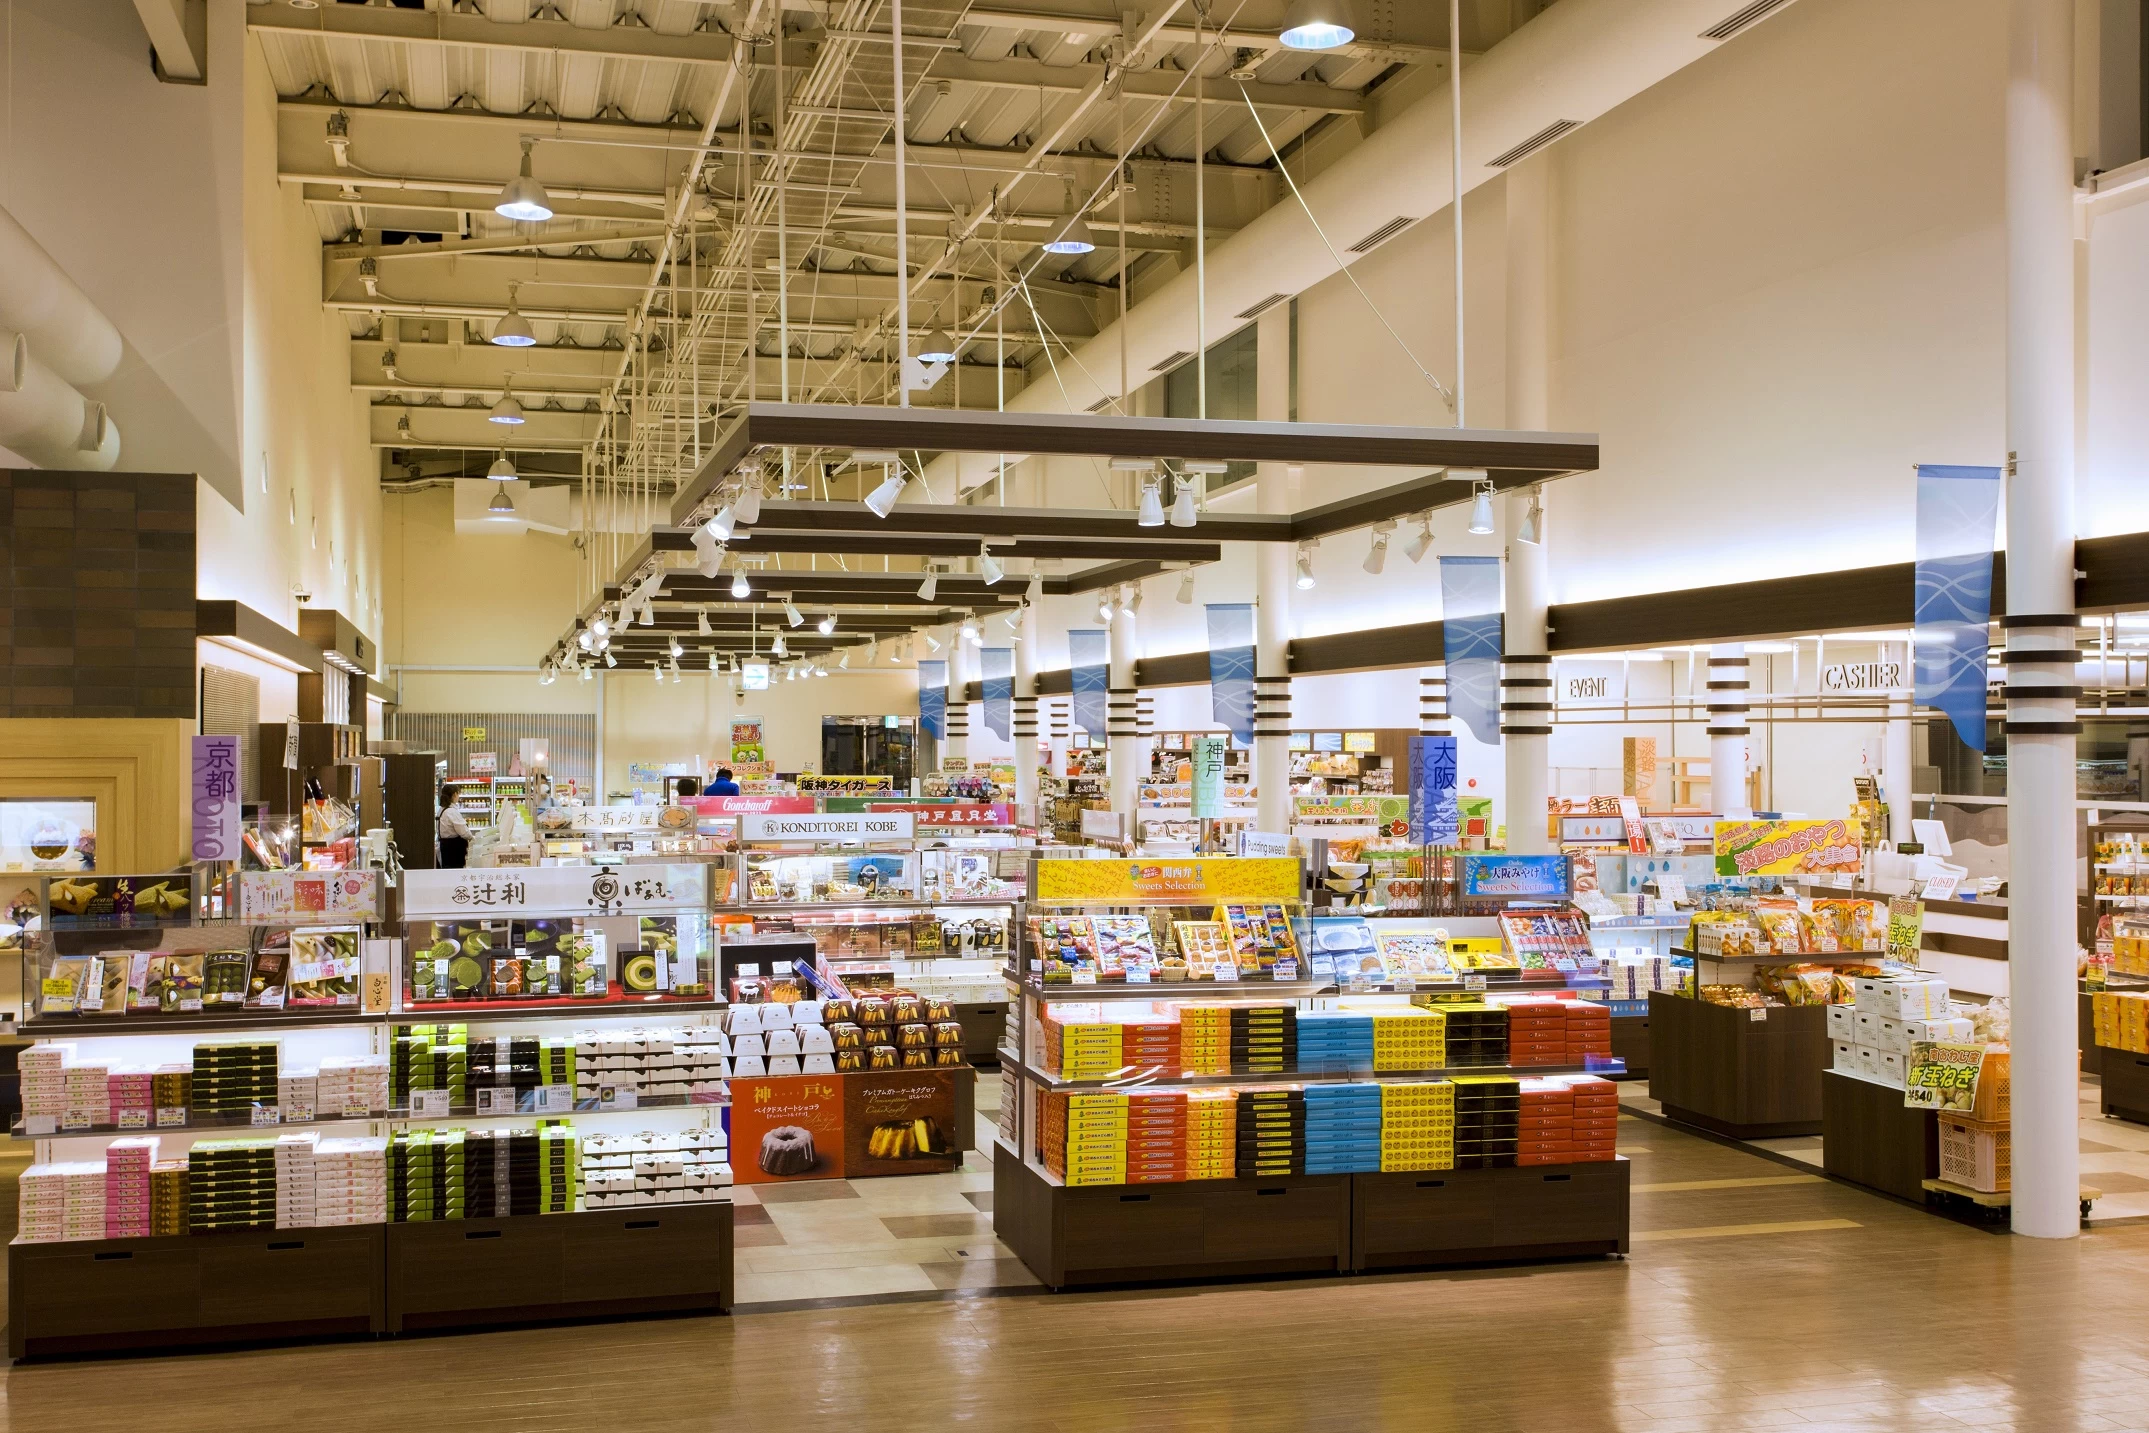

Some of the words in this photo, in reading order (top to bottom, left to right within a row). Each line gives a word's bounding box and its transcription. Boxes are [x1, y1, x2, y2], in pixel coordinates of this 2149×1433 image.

[1826, 663, 1900, 689] CASHIER
[1570, 677, 1607, 698] EVENT
[1206, 742, 1223, 778] 神戸
[1434, 741, 1456, 790] 大阪
[1642, 740, 1656, 772] 淡路
[205, 741, 234, 797] 京都
[801, 780, 891, 791] 阪神タイガース
[723, 798, 774, 811] Goncharoff
[781, 822, 858, 833] KONDITOREI
[865, 822, 897, 832] KOBE
[1718, 822, 1751, 843] 淡路島産
[1731, 823, 1773, 850] 玉ねぎ使用
[1248, 840, 1267, 856] Pudding
[1268, 844, 1286, 855] sweets
[1734, 820, 1846, 874] 淡路のおやつ
[1807, 844, 1858, 868] 大集合
[461, 873, 520, 881] 京都宇治総本家
[1162, 867, 1192, 878] 関西弁
[1491, 867, 1540, 879] 大阪みやげ
[1929, 876, 1954, 889] CLOSED
[473, 882, 525, 905] 辻利
[1133, 881, 1162, 890] Sweets
[1165, 880, 1206, 890] Selection
[1477, 881, 1508, 891] Sweets
[1511, 881, 1554, 892] Selection
[1888, 923, 1918, 947] 玉ねぎ
[1929, 1048, 1980, 1065] 南あわじ産
[1908, 1065, 1979, 1089] 新玉ねぎ
[753, 1086, 771, 1104] 神
[803, 1083, 820, 1100] 戸
[1908, 1090, 1932, 1102] ¥540
[754, 1104, 820, 1113] ベイクドスイートショコラ
